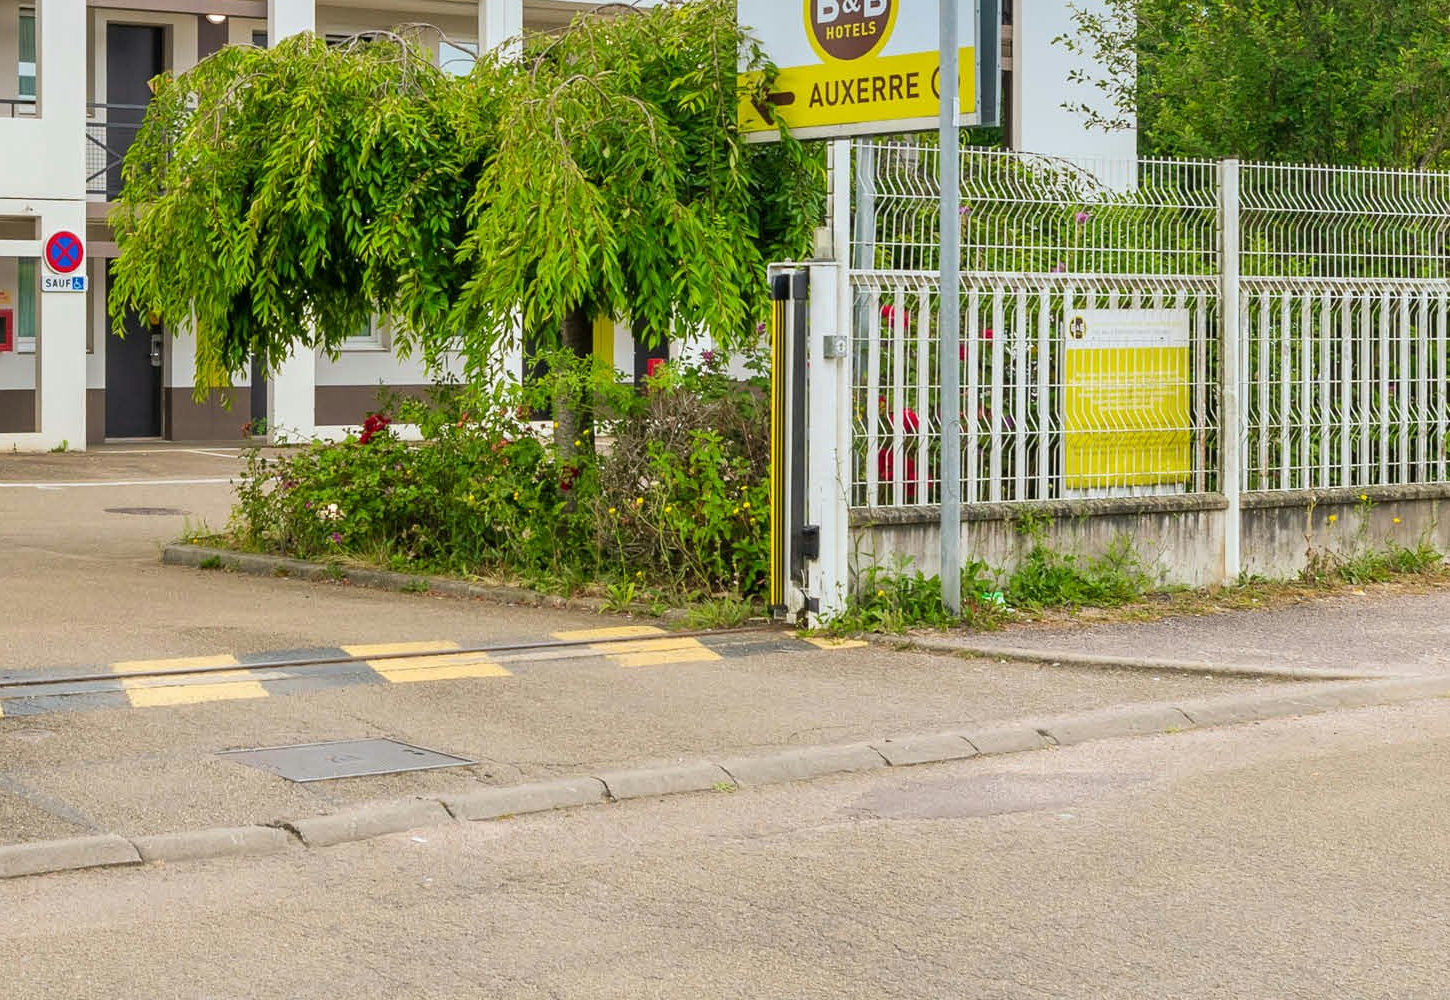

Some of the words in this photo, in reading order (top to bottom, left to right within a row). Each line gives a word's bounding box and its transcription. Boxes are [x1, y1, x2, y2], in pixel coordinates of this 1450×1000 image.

[826, 21, 876, 40] HOTELS
[809, 72, 919, 108] AUXERRE
[45, 278, 71, 288] SAUF
